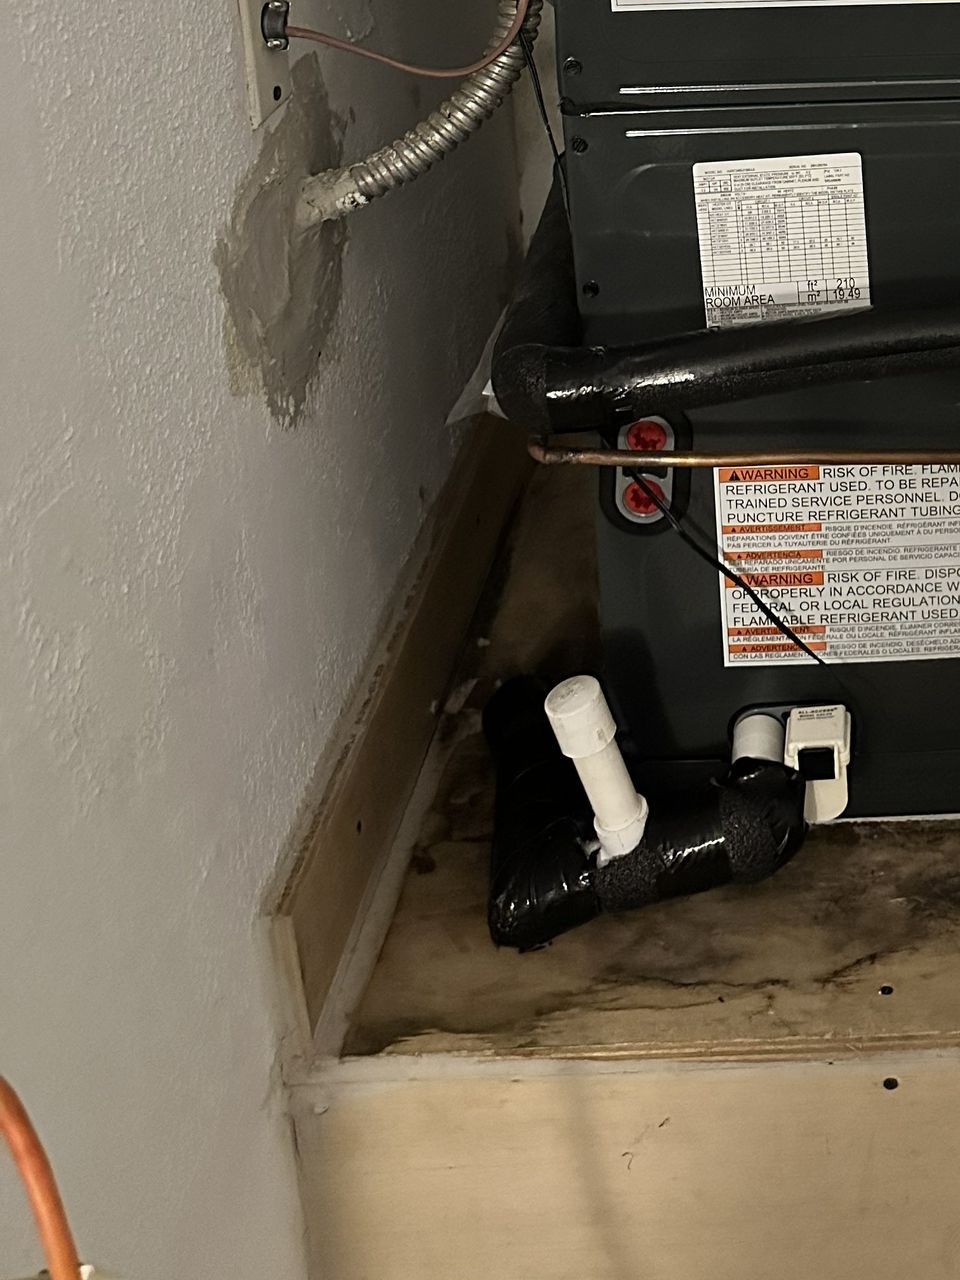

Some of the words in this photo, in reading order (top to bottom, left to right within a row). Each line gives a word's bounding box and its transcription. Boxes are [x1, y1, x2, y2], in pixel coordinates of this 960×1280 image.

[836, 278, 855, 288] 210
[705, 285, 756, 297] MINIMUM
[833, 289, 860, 300] 19.49
[706, 296, 741, 308] ROOM
[744, 295, 775, 305] AREA
[741, 469, 808, 479] WARNING
[823, 467, 855, 478] RISK
[859, 467, 878, 477] OF
[882, 465, 917, 476] FIRE.
[726, 482, 825, 495] REFRIGERANT
[829, 481, 871, 492] USED.
[875, 480, 894, 490] TO
[899, 479, 917, 489] BE
[727, 498, 787, 509] TRAINED
[792, 496, 852, 508] SERVICE
[856, 491, 944, 506] PERSONNEL.
[727, 511, 803, 523] PUNCTURE
[808, 507, 906, 521] REFRIGERANT
[747, 573, 813, 585] WARNING
[828, 572, 859, 583] RISK
[863, 572, 882, 582] OF
[886, 570, 920, 581] FIRE.
[830, 587, 842, 597] IN
[847, 582, 943, 596] ACCORDANCE
[733, 602, 795, 613] FEDRAL
[800, 601, 819, 611] OR
[824, 599, 868, 610] LOCAL
[820, 610, 917, 624] REFRIGERANT
